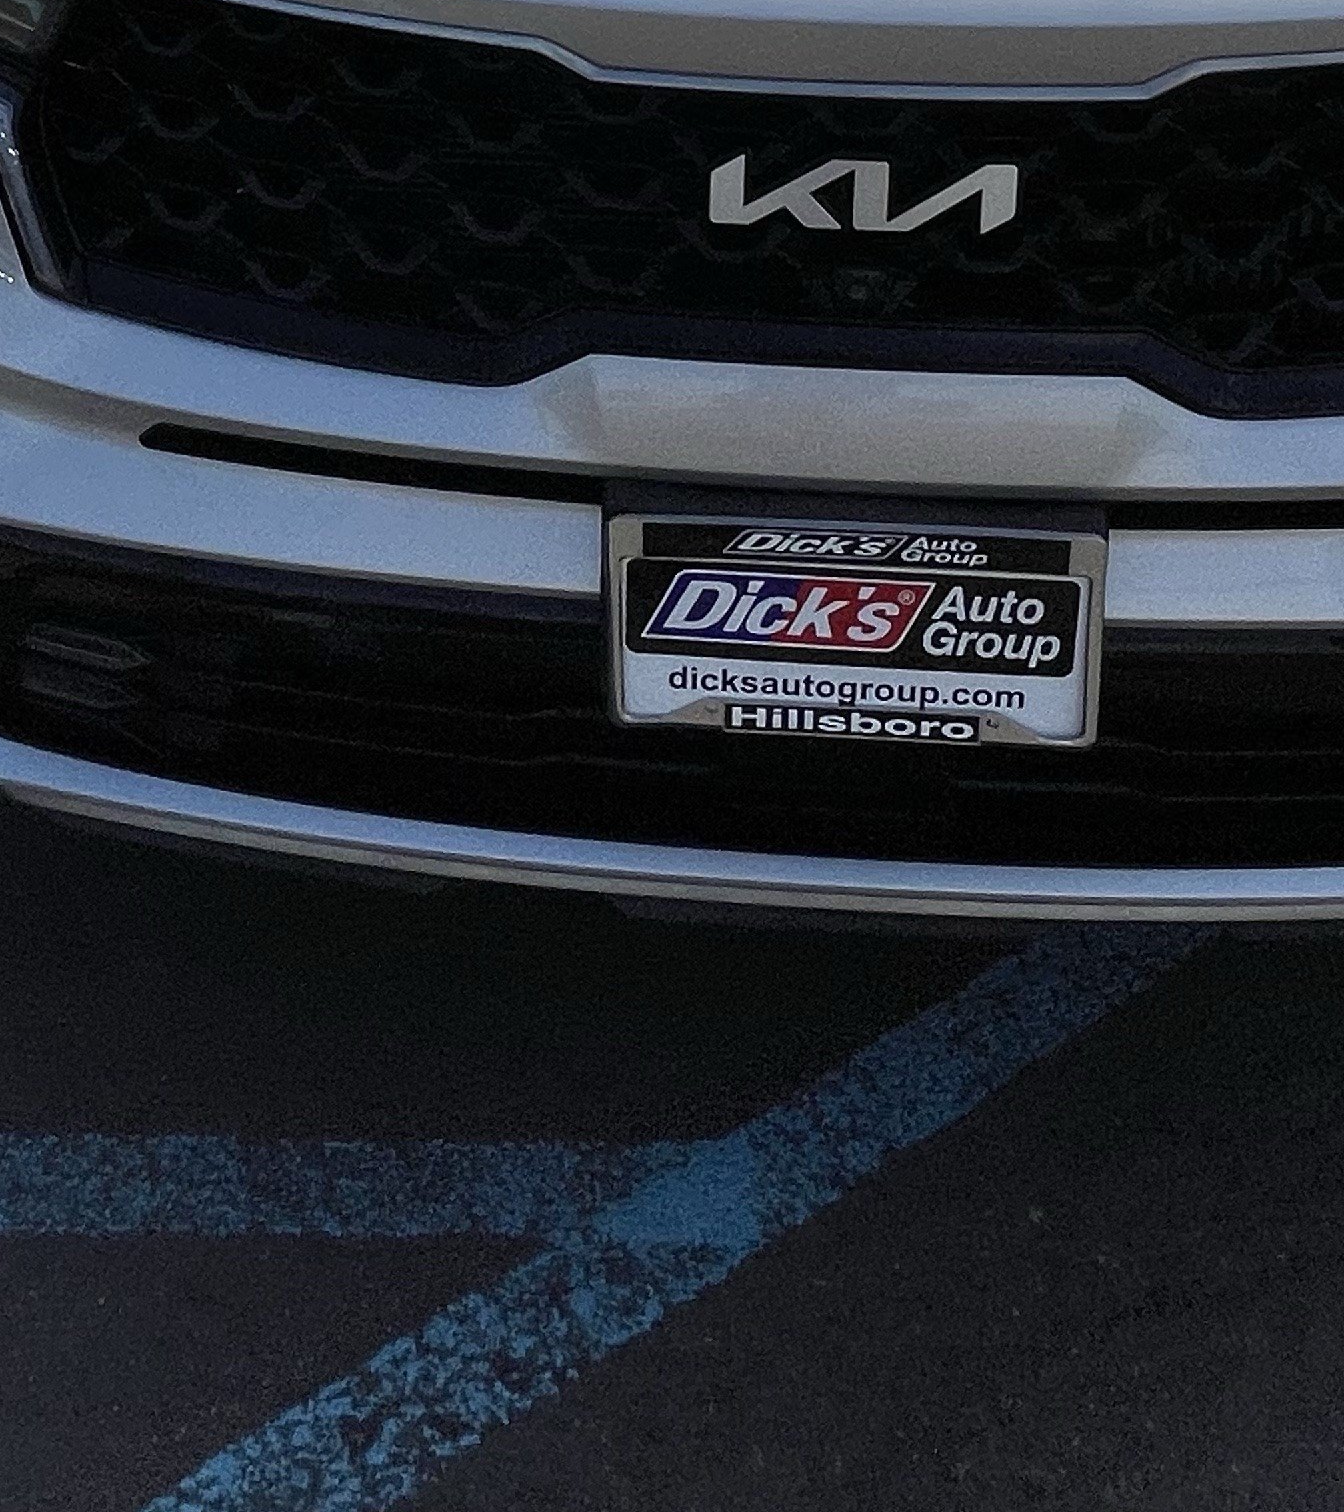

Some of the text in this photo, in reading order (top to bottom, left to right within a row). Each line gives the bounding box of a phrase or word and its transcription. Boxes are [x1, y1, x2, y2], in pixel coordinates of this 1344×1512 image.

[709, 154, 1018, 234] KIA
[737, 534, 887, 557] Dick's
[900, 550, 988, 567] Group
[911, 536, 977, 552] Auto
[662, 579, 901, 642] Dick's
[932, 586, 1045, 624] Auto
[922, 622, 1061, 669] Group
[668, 665, 1025, 709] dicksautogroup.com
[730, 706, 974, 740] Hillsboro
